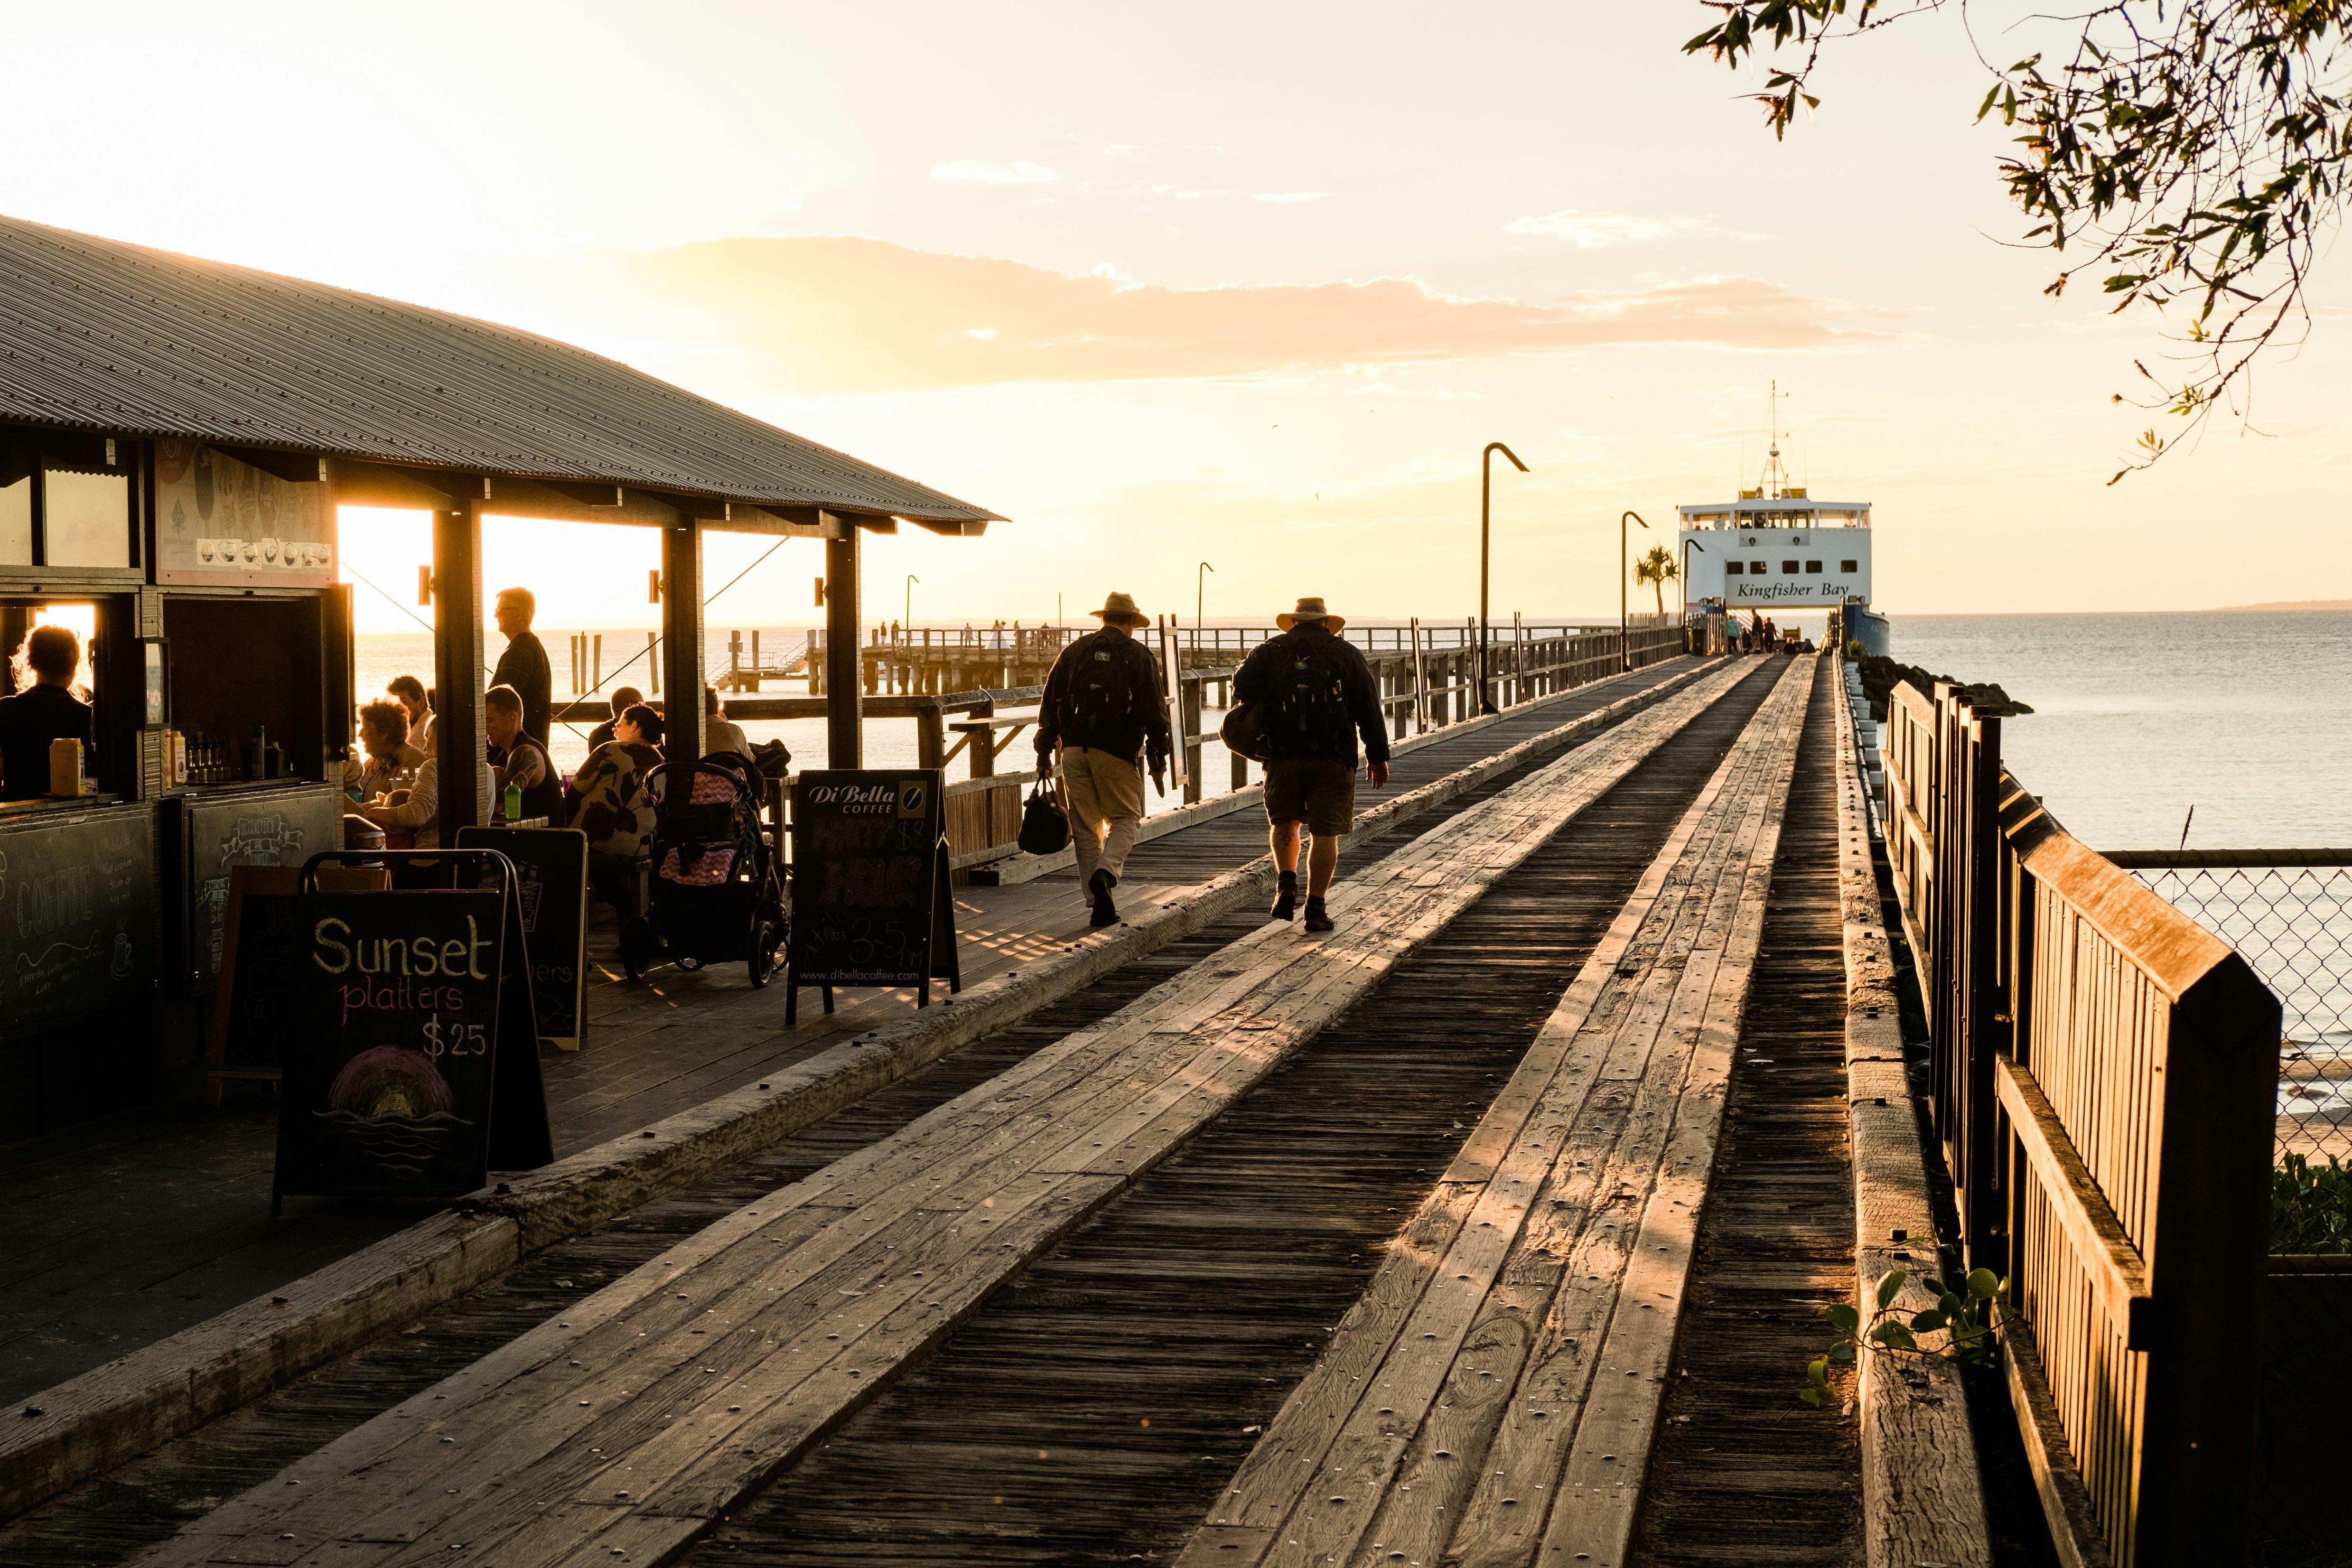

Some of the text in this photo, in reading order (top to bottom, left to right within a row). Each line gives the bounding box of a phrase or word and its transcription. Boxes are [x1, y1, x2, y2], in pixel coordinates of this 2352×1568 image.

[1737, 582, 1849, 600] Kingfisher Bay
[809, 785, 896, 803] Di Bella
[842, 804, 893, 814] COFFEE
[895, 819, 926, 851] $8
[17, 865, 93, 939] COFFEE
[312, 915, 494, 980] Sunset
[898, 949, 924, 968] PM
[799, 969, 919, 981] www.dibellacoffee.com
[338, 976, 464, 1027] platters
[422, 1013, 487, 1063] $25
